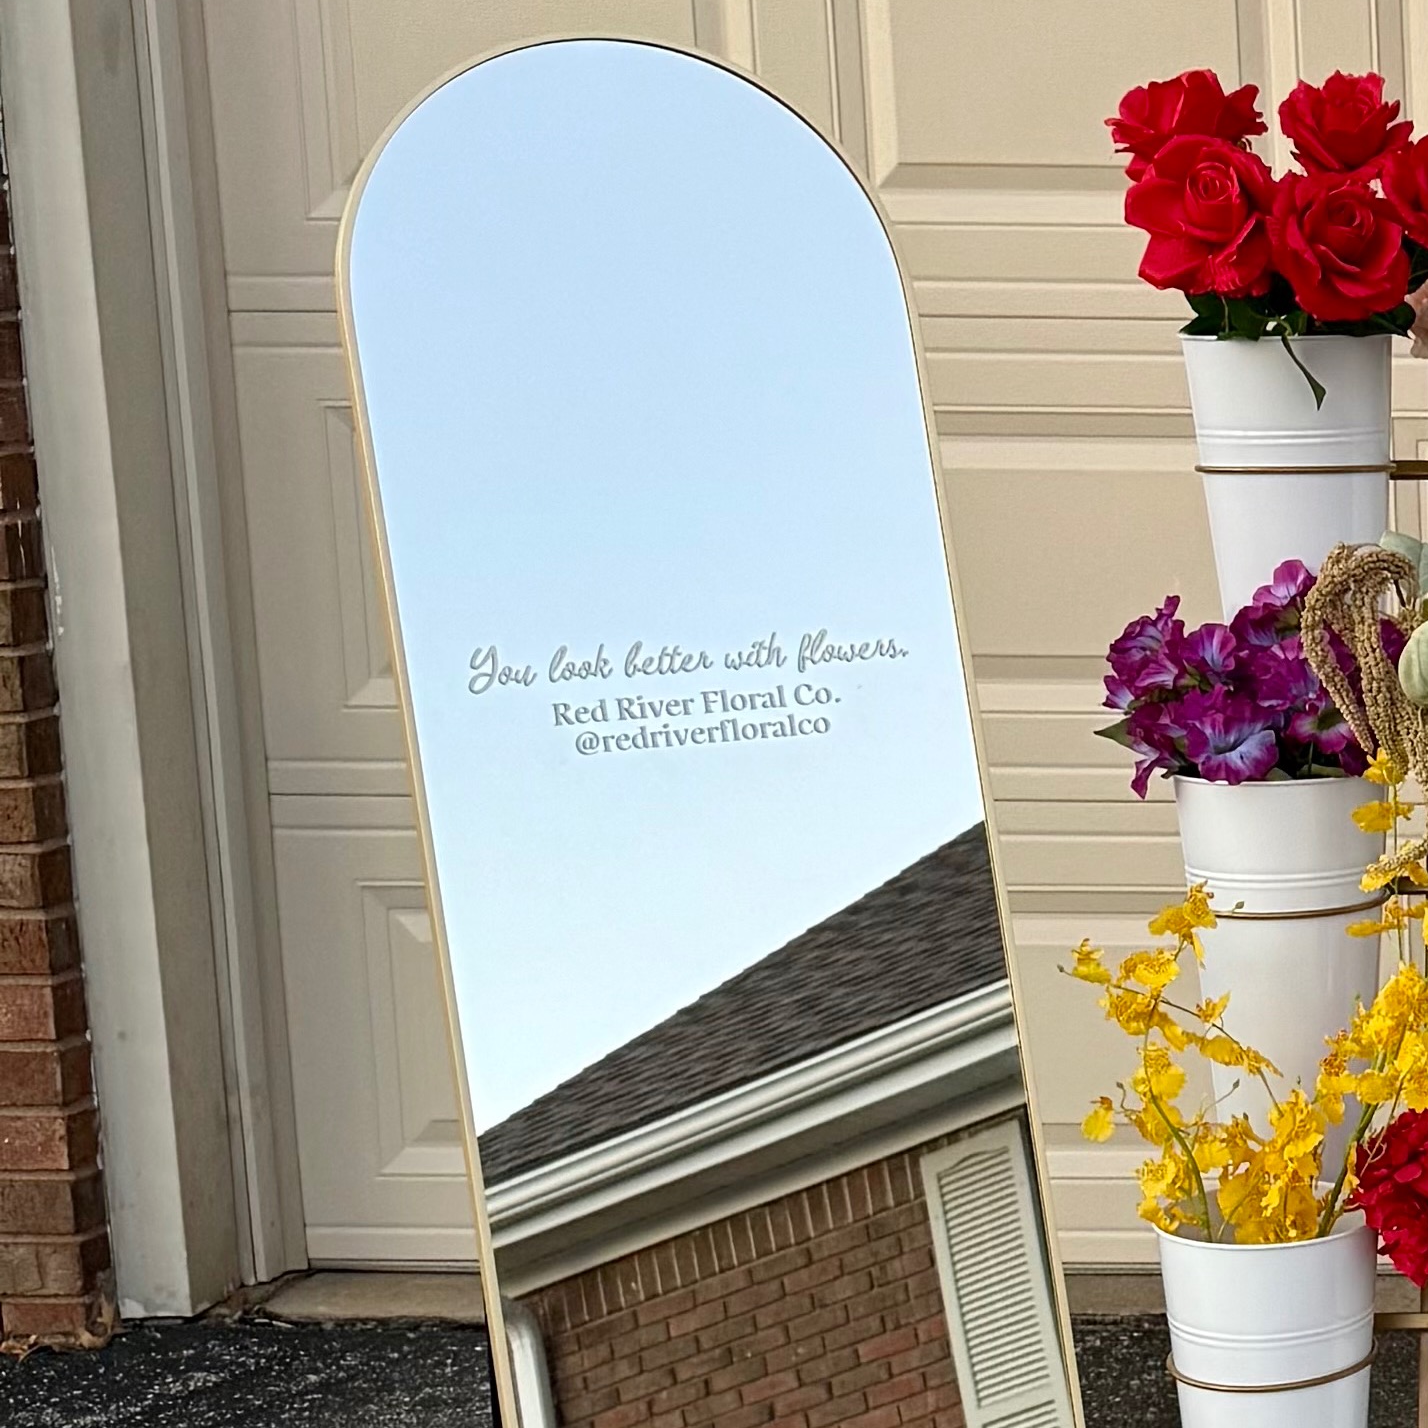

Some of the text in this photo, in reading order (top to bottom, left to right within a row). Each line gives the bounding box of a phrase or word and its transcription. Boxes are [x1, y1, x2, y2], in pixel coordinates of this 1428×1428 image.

[467, 628, 910, 696] You look better with flowers.
[551, 683, 843, 727] Red River Floral Co.
[574, 713, 832, 756] @redriverfloralco
